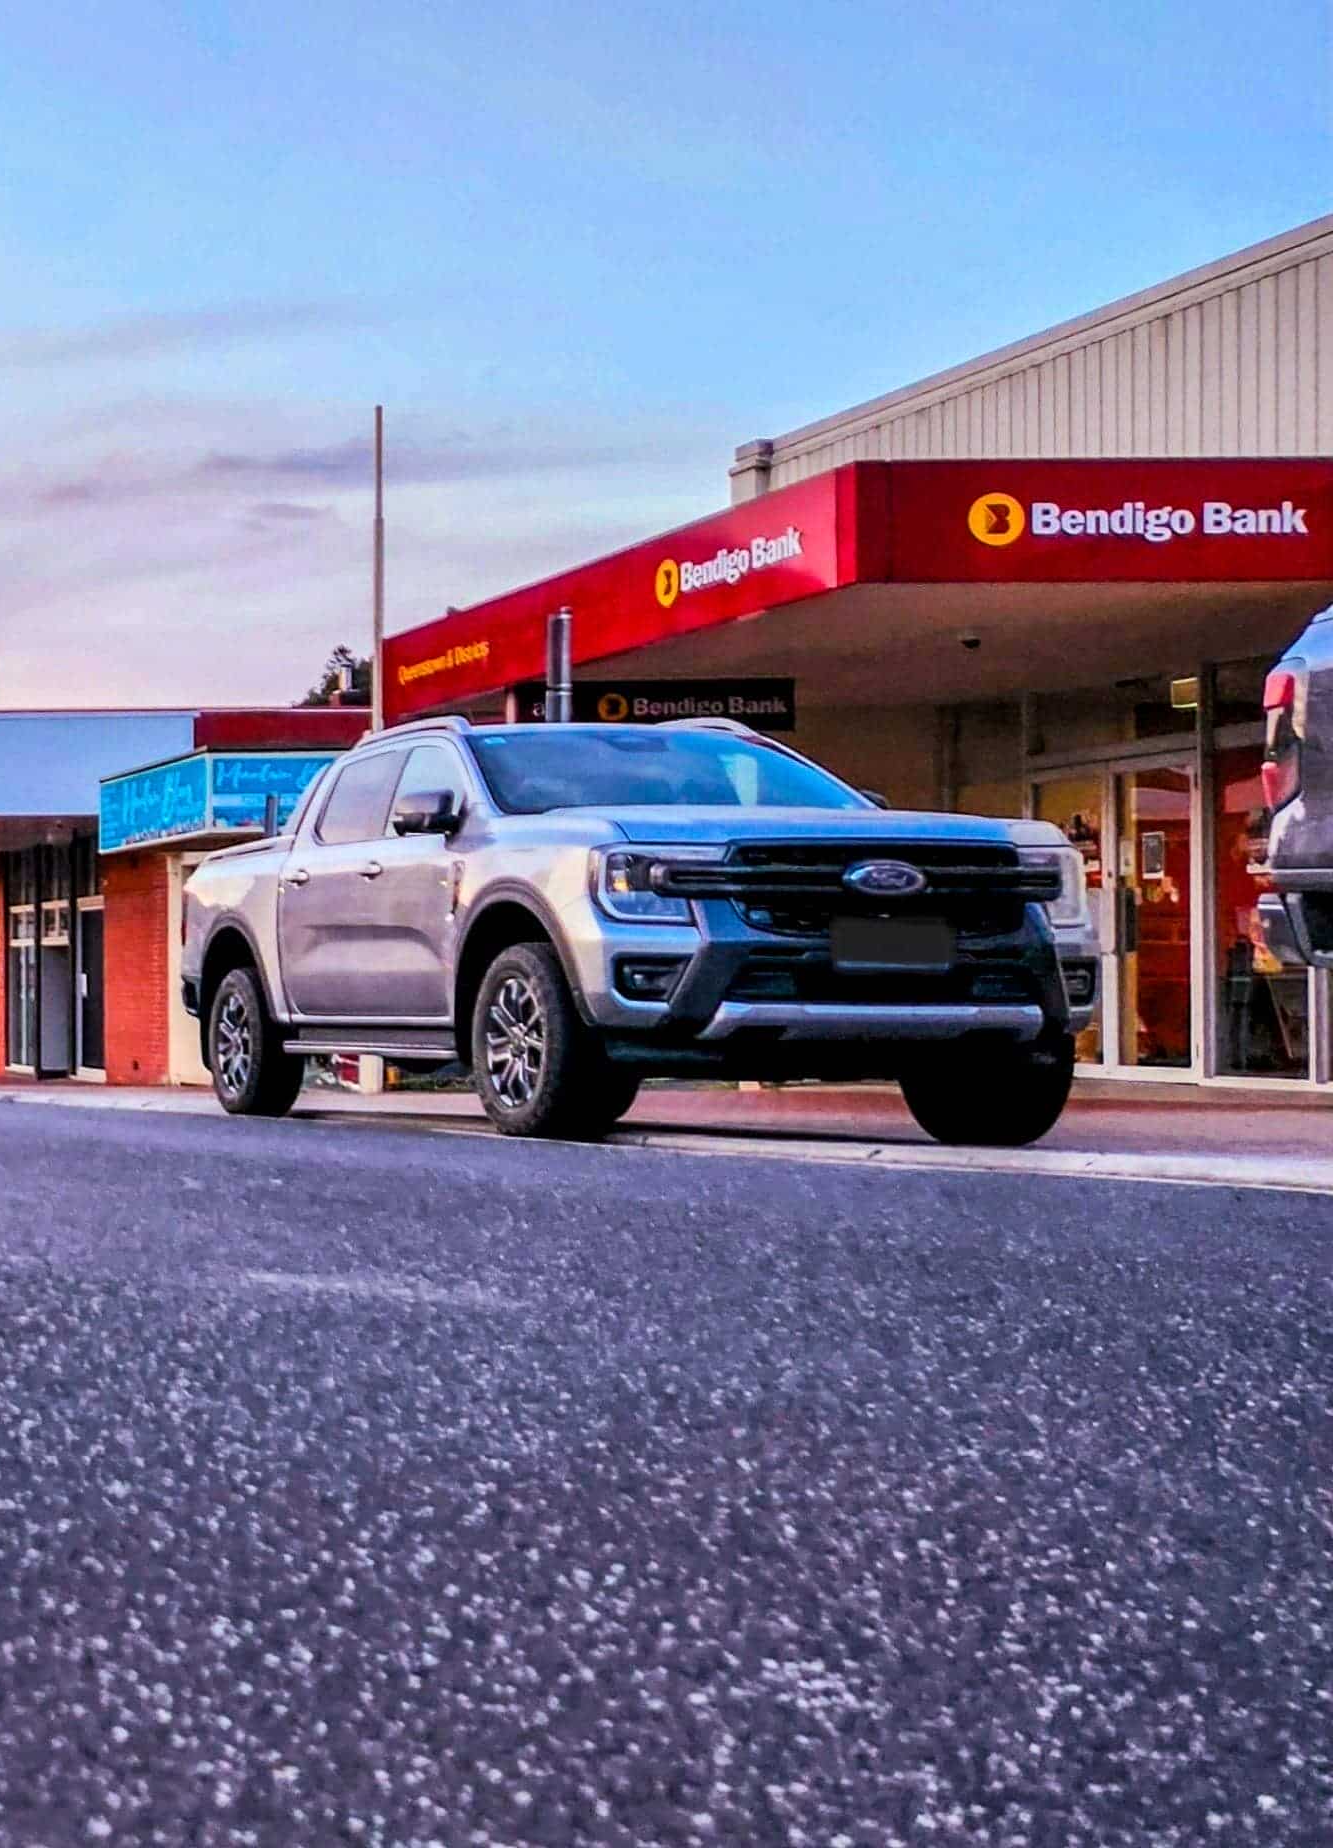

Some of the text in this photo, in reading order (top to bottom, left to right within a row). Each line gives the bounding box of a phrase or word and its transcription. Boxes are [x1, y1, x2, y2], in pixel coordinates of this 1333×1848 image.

[1031, 500, 1309, 542] Bendigo Bank
[679, 526, 803, 592] Bendigo Bank
[633, 697, 788, 717] Bendigo Bank
